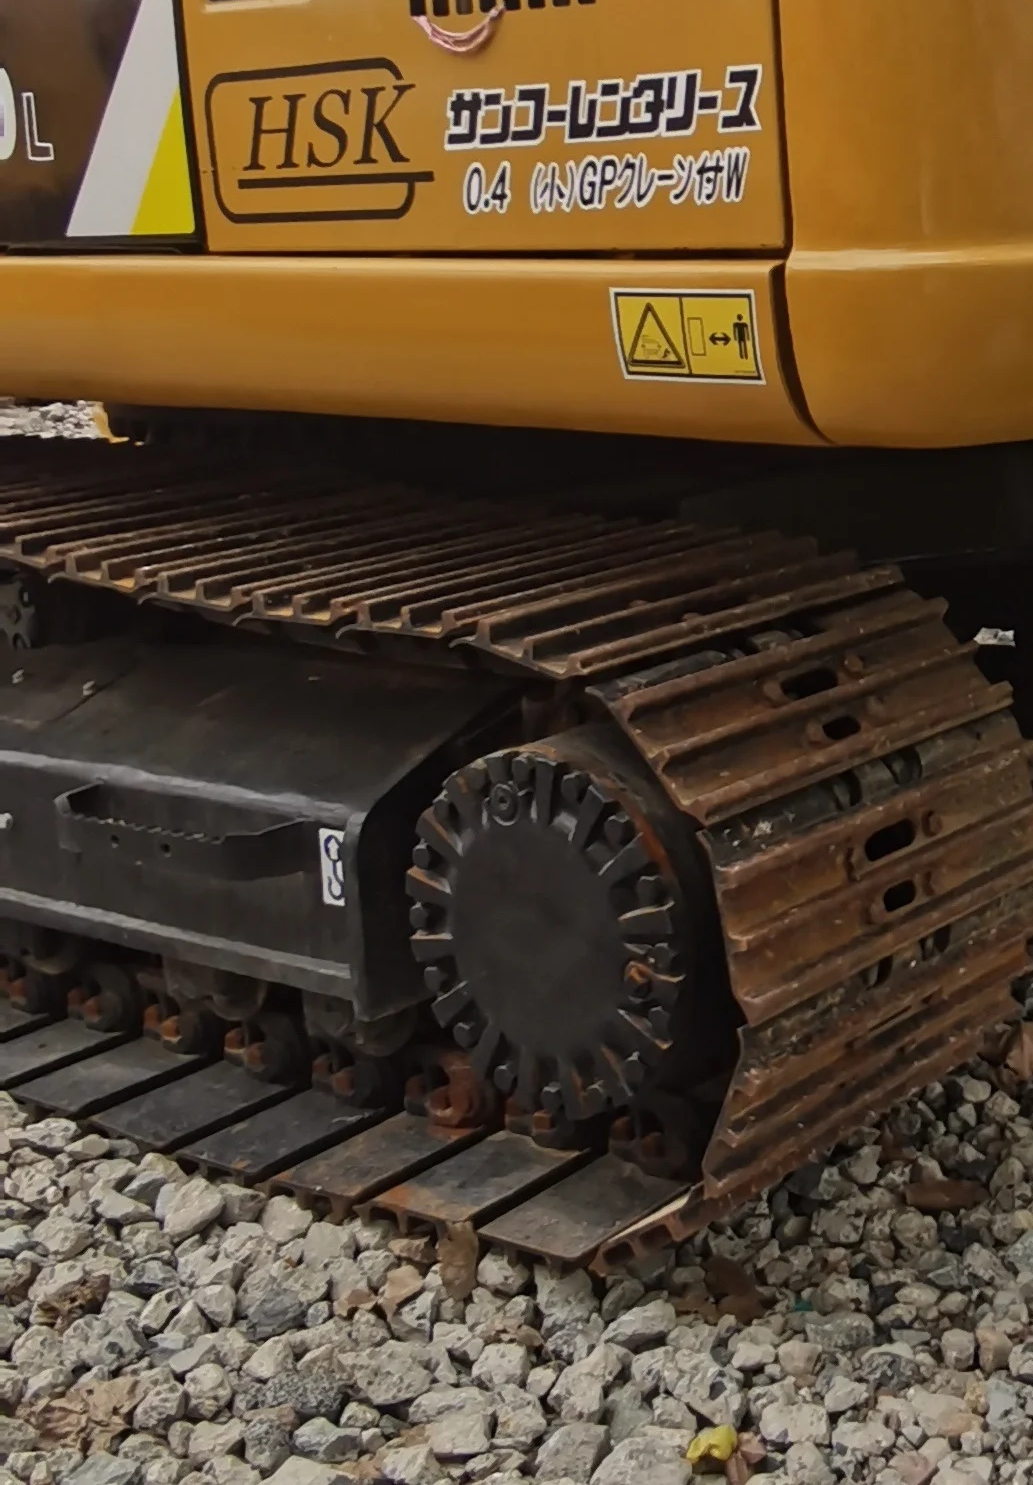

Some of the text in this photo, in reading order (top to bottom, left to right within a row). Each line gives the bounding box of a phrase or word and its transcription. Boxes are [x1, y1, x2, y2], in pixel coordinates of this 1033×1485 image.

[243, 83, 416, 171] HSK
[446, 66, 761, 148] サンコーレンタリース
[464, 163, 510, 212] 0.4
